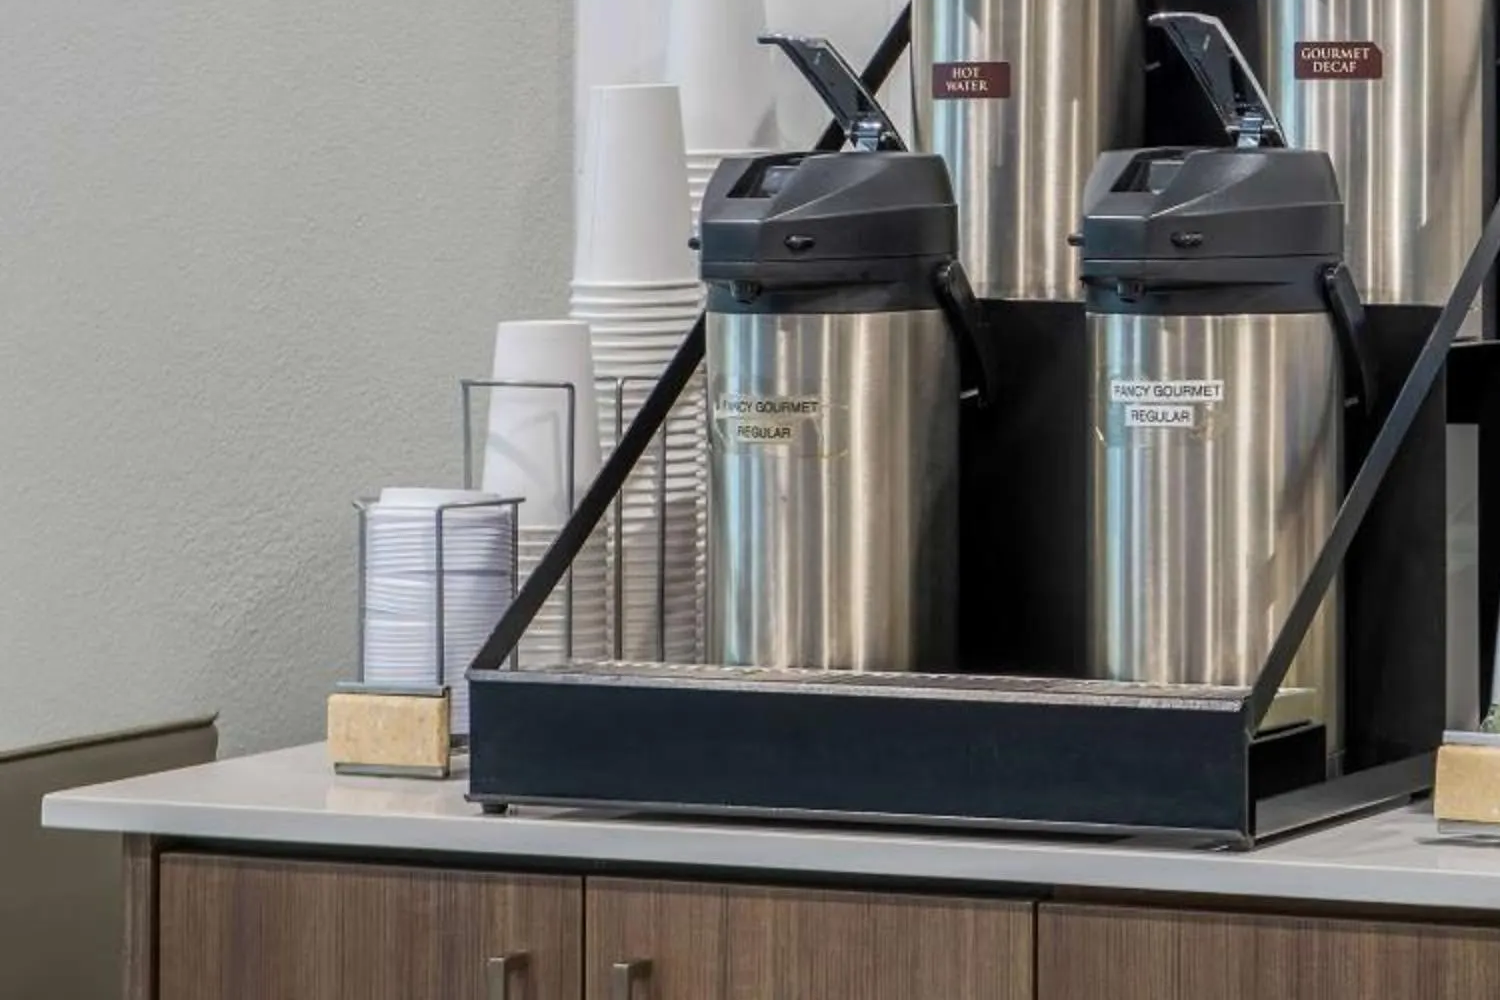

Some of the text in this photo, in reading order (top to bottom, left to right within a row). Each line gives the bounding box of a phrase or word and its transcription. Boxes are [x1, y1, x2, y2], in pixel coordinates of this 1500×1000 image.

[1301, 47, 1370, 60] GOURMET
[952, 67, 980, 79] HOT
[1313, 61, 1357, 73] DECAF
[945, 80, 989, 92] WATER
[1113, 385, 1220, 397] FANCY GOURMET
[755, 401, 819, 414] GOURMET
[1131, 409, 1190, 422] REGULAR
[737, 425, 791, 439] REGULAR
